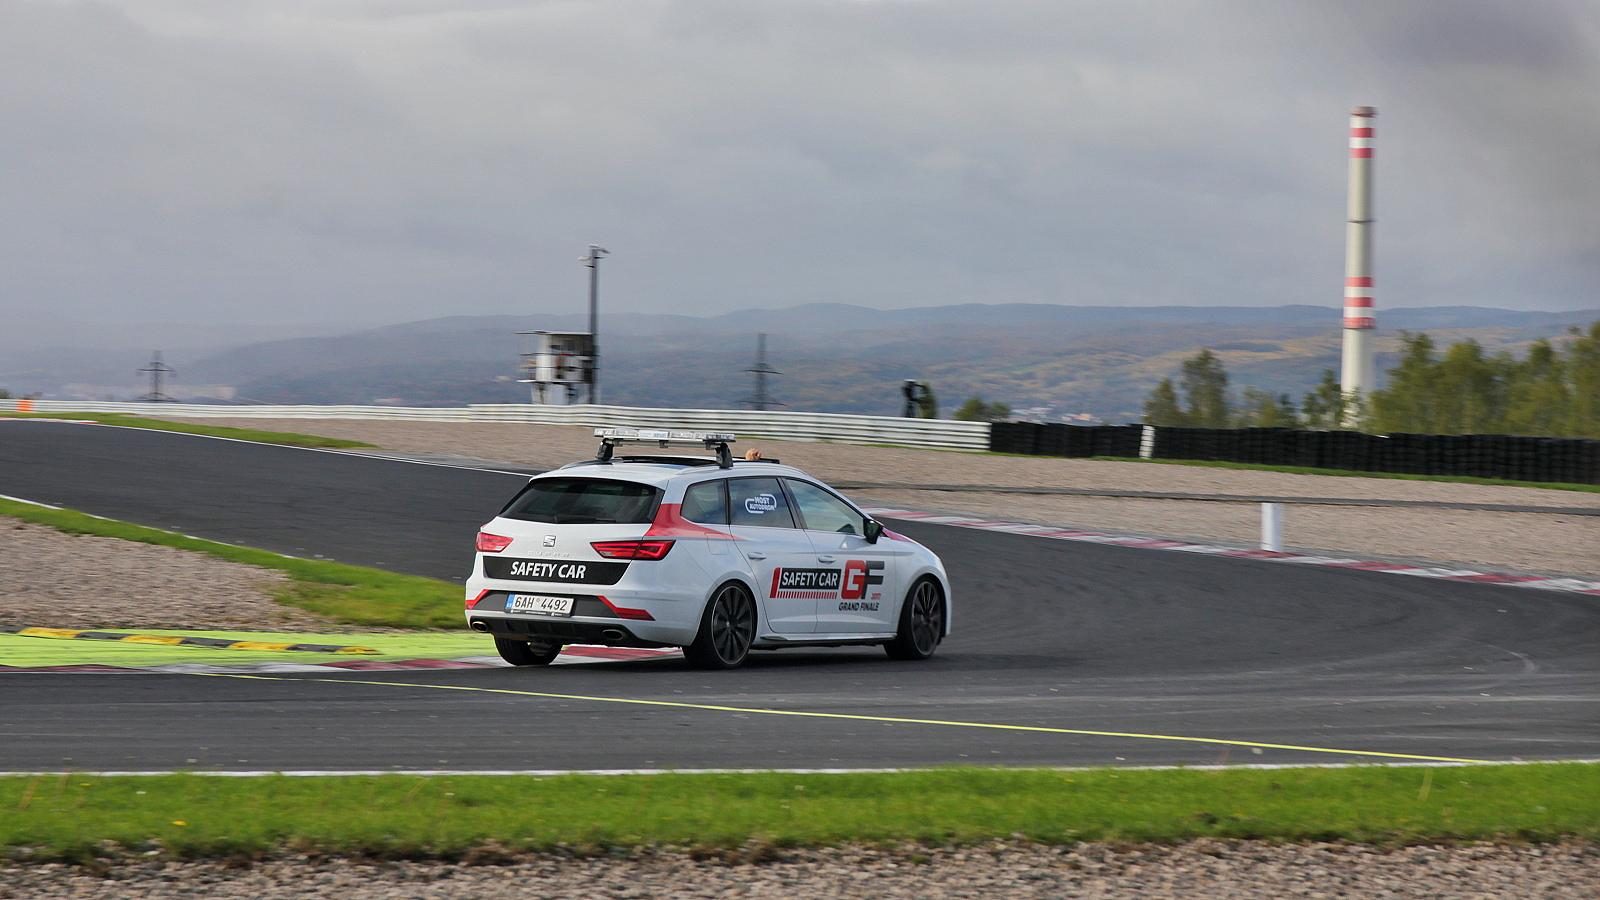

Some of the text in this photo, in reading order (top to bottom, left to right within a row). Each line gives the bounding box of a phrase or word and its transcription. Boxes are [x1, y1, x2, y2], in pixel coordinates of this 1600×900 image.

[754, 496, 770, 504] MOST
[510, 561, 587, 579] SAFETY CAR
[782, 572, 838, 587] SAFETY CAR
[841, 559, 885, 600] GF
[515, 596, 568, 611] 6AH 4492
[838, 602, 880, 611] GRAND FINALE
